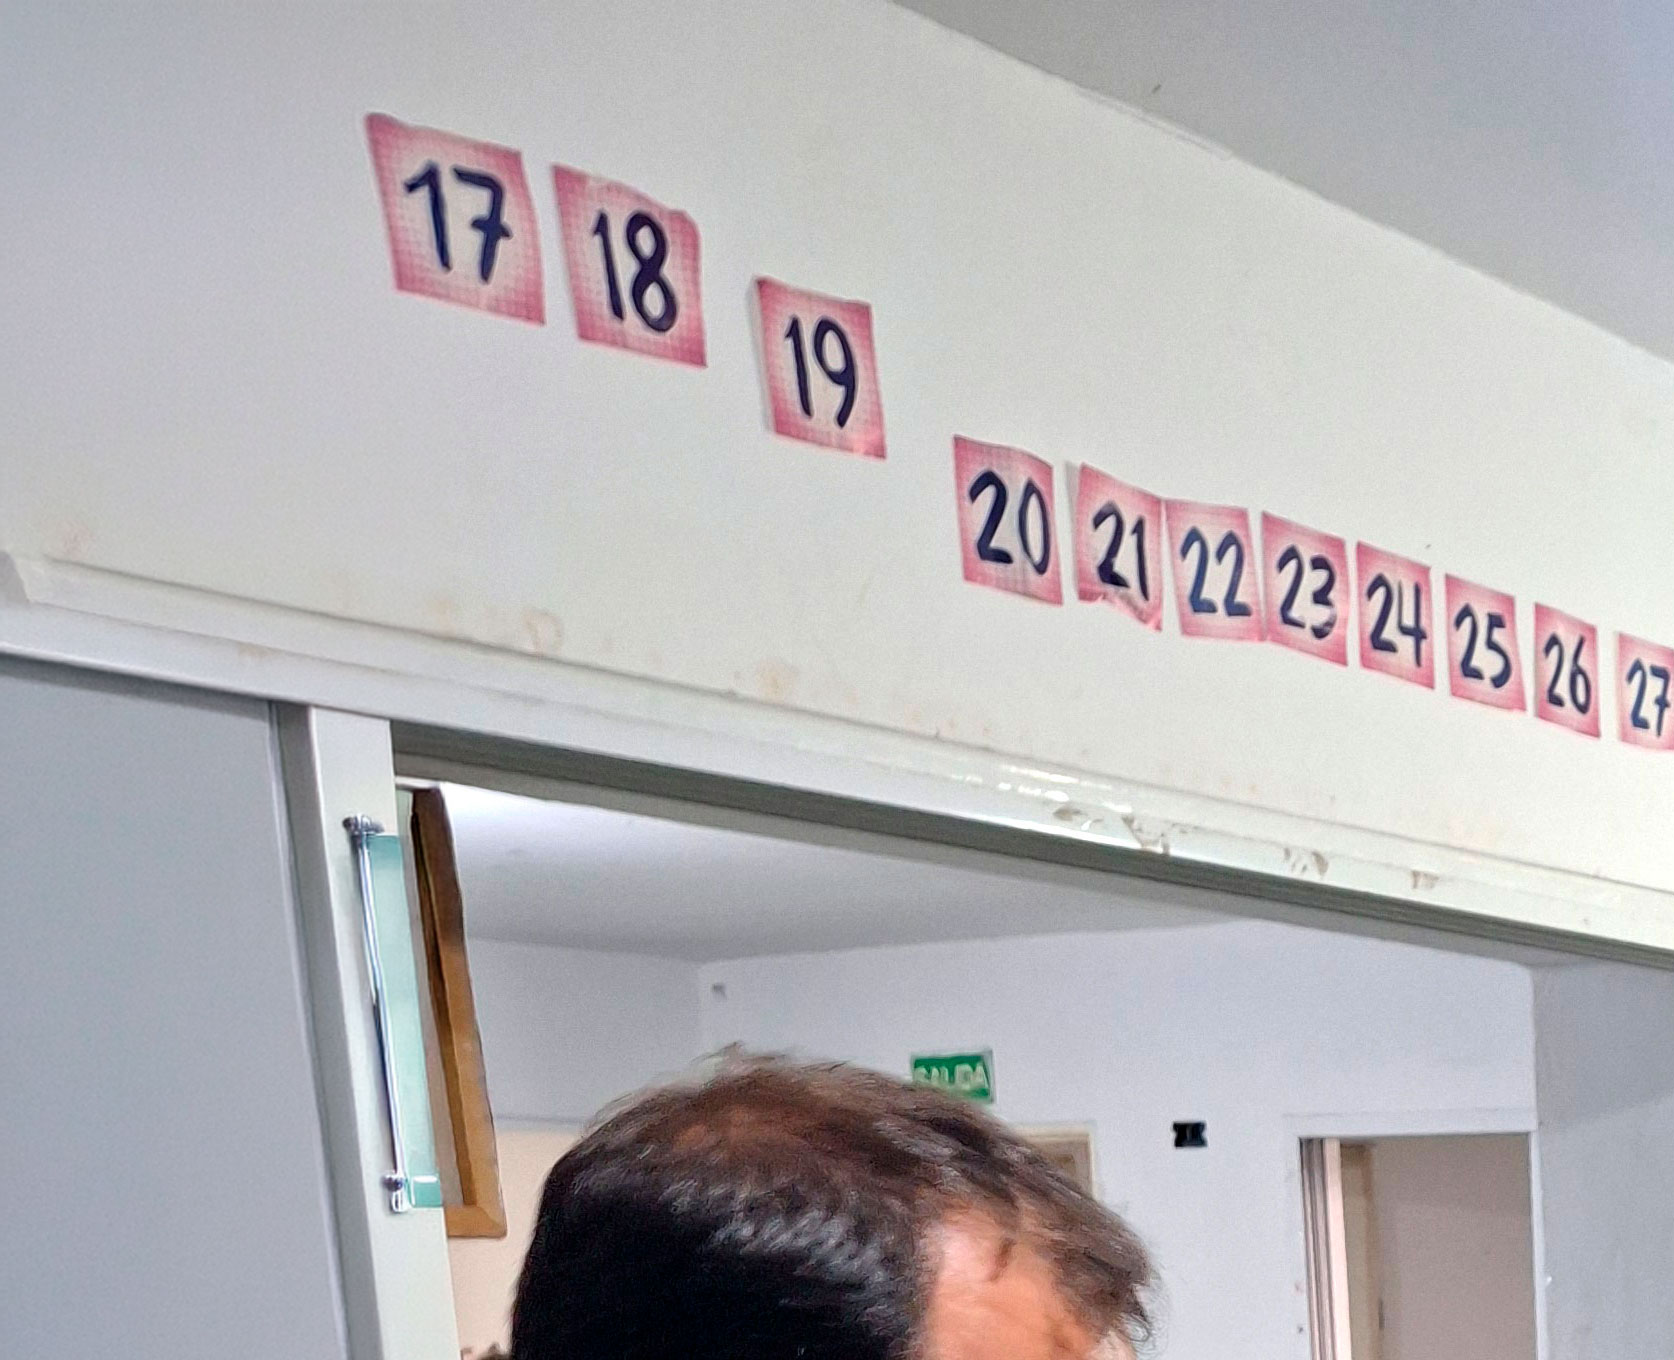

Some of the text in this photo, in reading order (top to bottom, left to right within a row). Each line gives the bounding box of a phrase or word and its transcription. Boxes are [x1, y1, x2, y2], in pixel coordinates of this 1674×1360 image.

[403, 160, 512, 284] 17
[592, 209, 678, 334] 18
[784, 316, 857, 429] 19
[968, 469, 1051, 576] 20
[1092, 503, 1149, 602] 21
[1180, 527, 1252, 617] 22
[1276, 545, 1336, 640] 23
[1366, 573, 1428, 667] 24
[1454, 604, 1512, 689] 25
[1543, 634, 1591, 715] 26
[1627, 659, 1670, 736] 27
